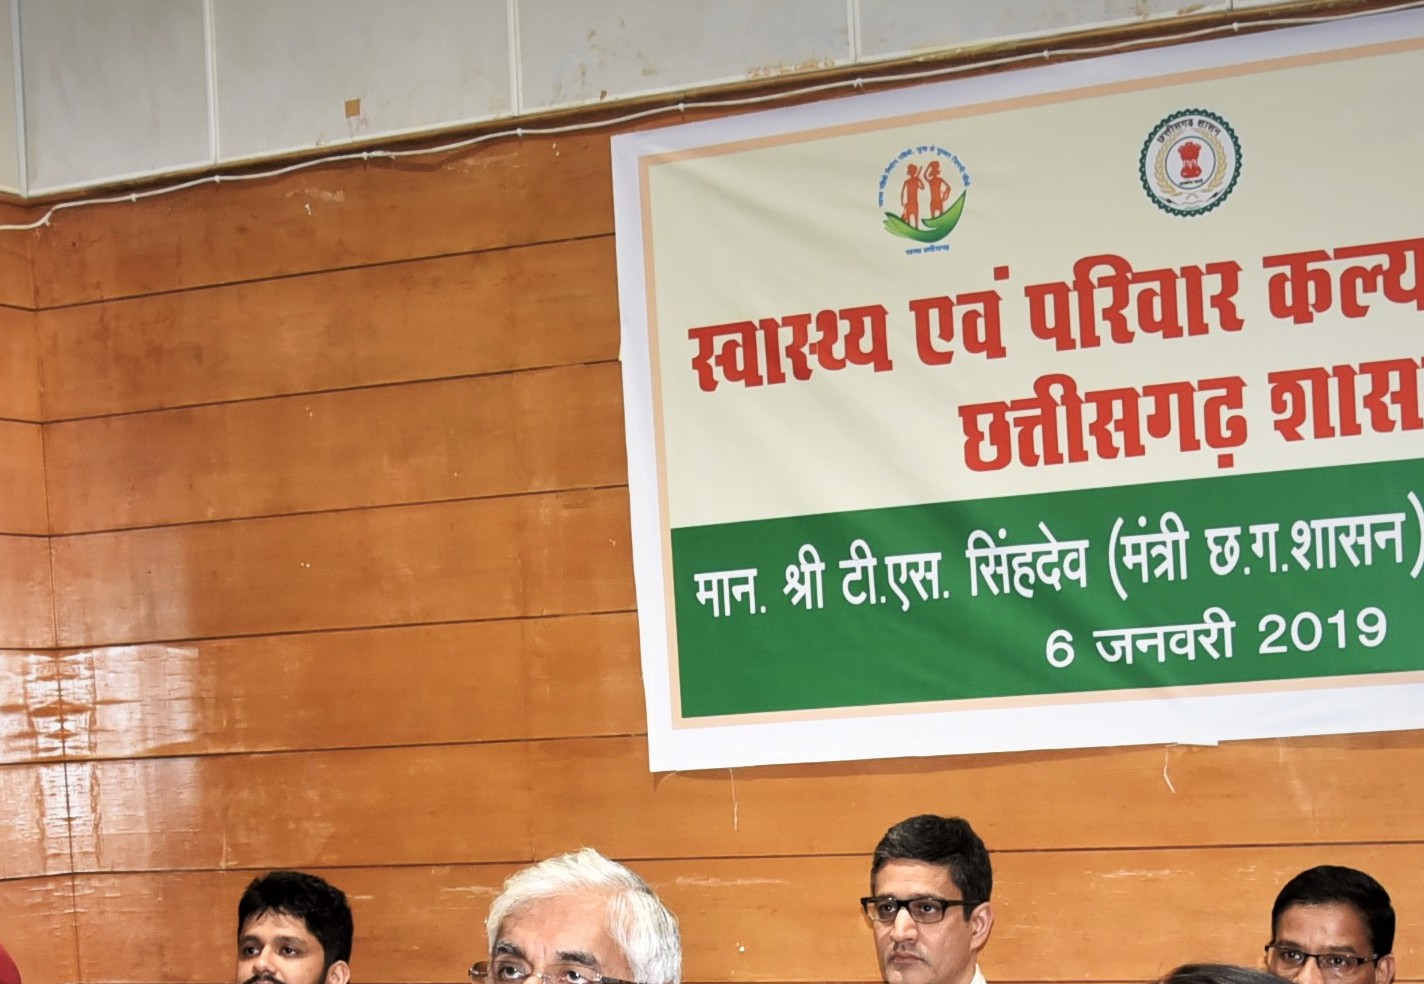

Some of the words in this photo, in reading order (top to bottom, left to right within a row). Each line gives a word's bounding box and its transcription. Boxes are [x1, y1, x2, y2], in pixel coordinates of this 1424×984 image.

[1197, 119, 1221, 136] शासन
[688, 304, 893, 392] स्वास्थ्य
[909, 265, 1007, 366] एवं
[1025, 253, 1245, 352] परिवार
[958, 373, 1248, 472] छत्तीसगढ़
[694, 568, 767, 617] मान.
[782, 544, 824, 609] श्री
[839, 539, 950, 612] टी.एस.
[966, 521, 1088, 598] सिंहदेव
[1108, 511, 1189, 600] (मंत्री
[1046, 629, 1075, 668] 6
[1093, 606, 1236, 665] जनवरी
[1258, 606, 1388, 654] 2019
